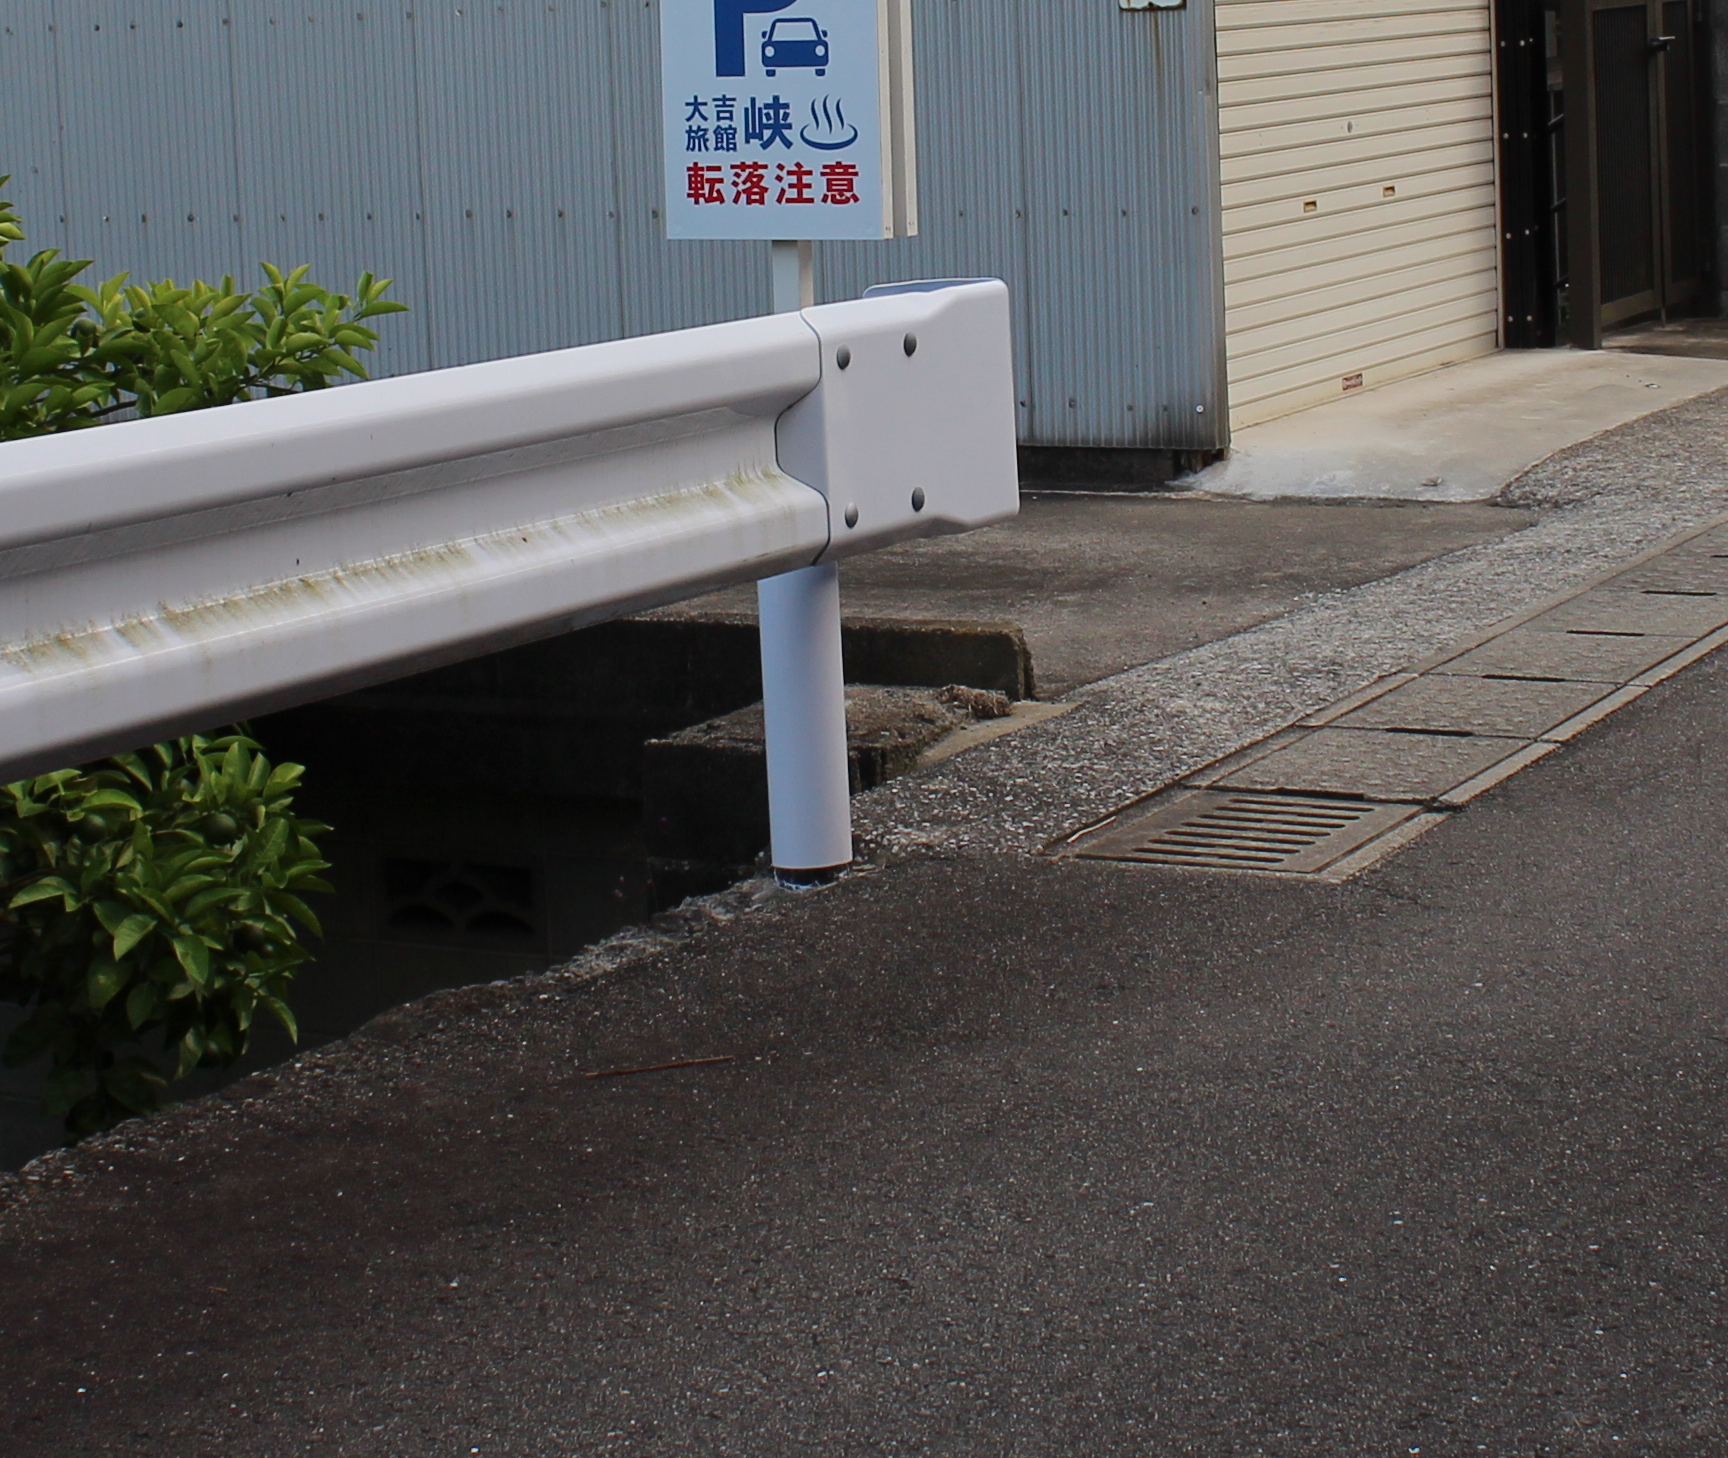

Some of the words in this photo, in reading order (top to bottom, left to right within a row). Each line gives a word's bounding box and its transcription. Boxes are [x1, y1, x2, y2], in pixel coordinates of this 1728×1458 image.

[684, 94, 738, 122] 大吉
[744, 94, 794, 151] 峡
[684, 124, 738, 153] 旅館
[685, 160, 861, 207] 転落注意
